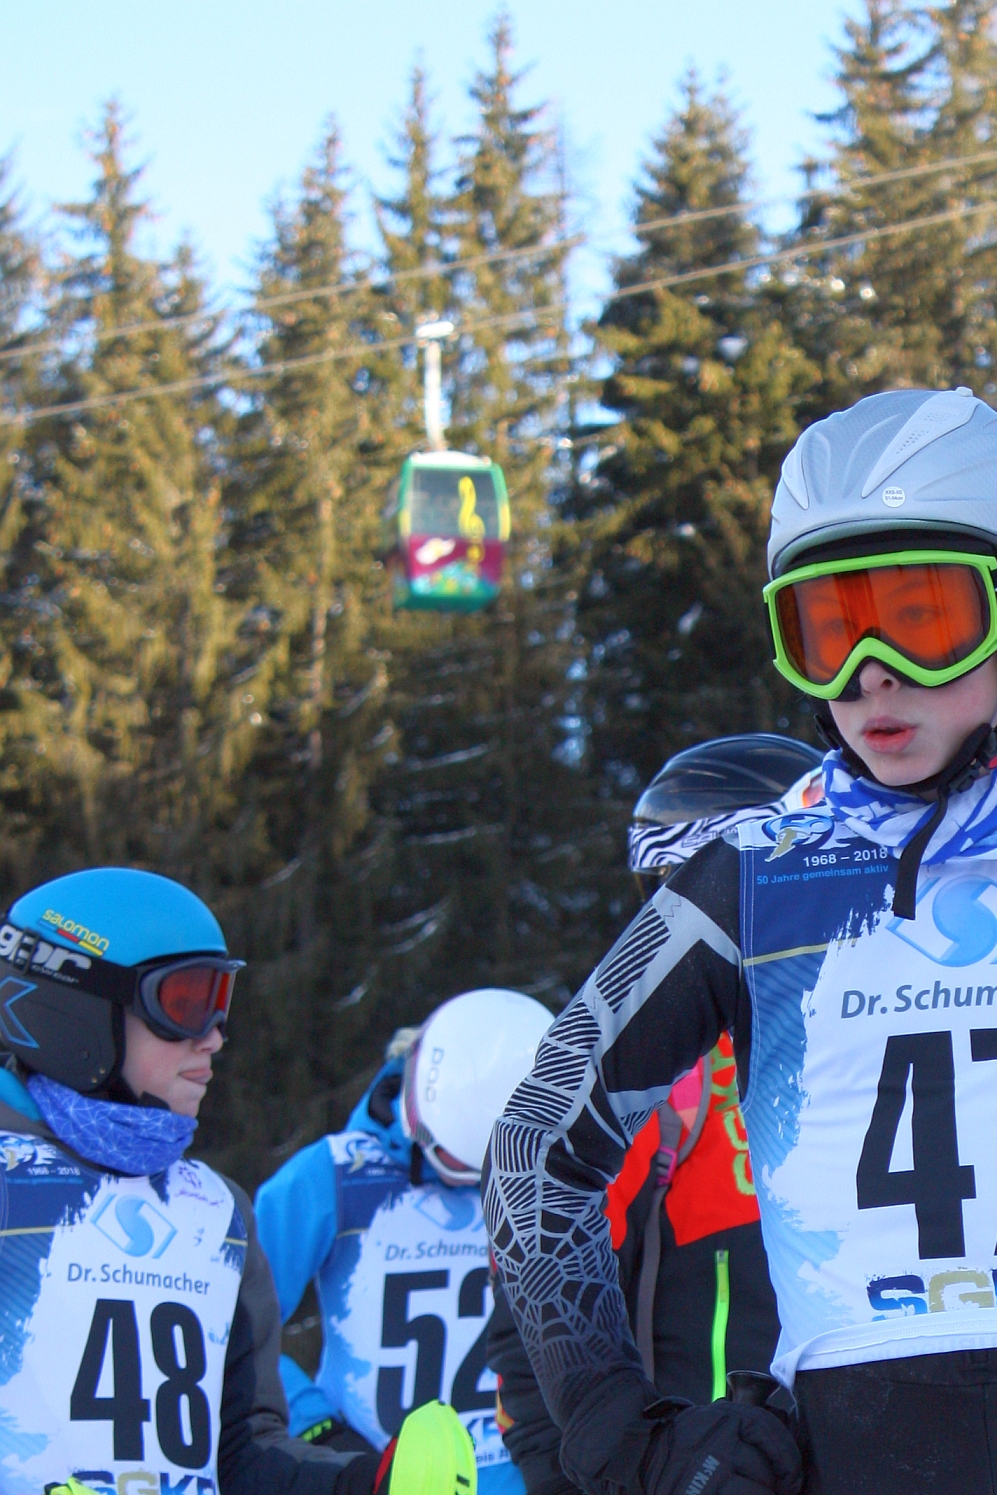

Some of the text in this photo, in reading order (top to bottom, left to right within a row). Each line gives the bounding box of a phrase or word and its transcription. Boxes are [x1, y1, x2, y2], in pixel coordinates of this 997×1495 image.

[803, 853, 837, 867] 1968
[853, 847, 889, 862] 2018
[756, 863, 890, 885] 50 Jahre gemeinsam aktiv
[41, 908, 110, 952] salomon
[840, 987, 889, 1019] Dr.
[385, 1238, 489, 1262] Dr. Schuma
[67, 1263, 211, 1296] Dr. Schumacher
[376, 1266, 496, 1436] 52
[69, 1298, 213, 1471] 48
